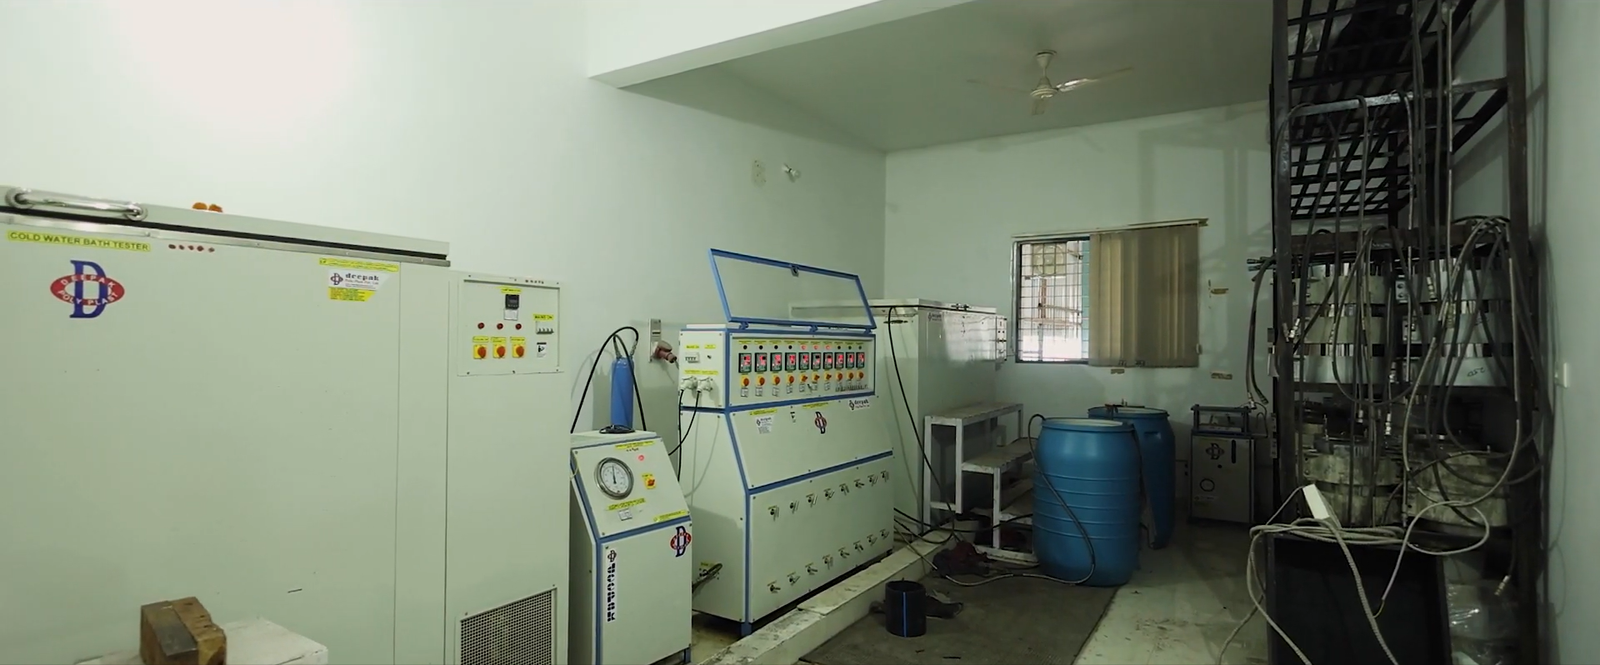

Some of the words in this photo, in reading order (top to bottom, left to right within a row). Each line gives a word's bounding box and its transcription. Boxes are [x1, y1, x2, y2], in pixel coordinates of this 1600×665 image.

[9, 232, 41, 242] COLD
[44, 234, 80, 245] WATER
[83, 238, 110, 248] BATH
[113, 241, 149, 251] TESTER
[345, 273, 379, 281] deepak
[58, 289, 83, 304] POLY
